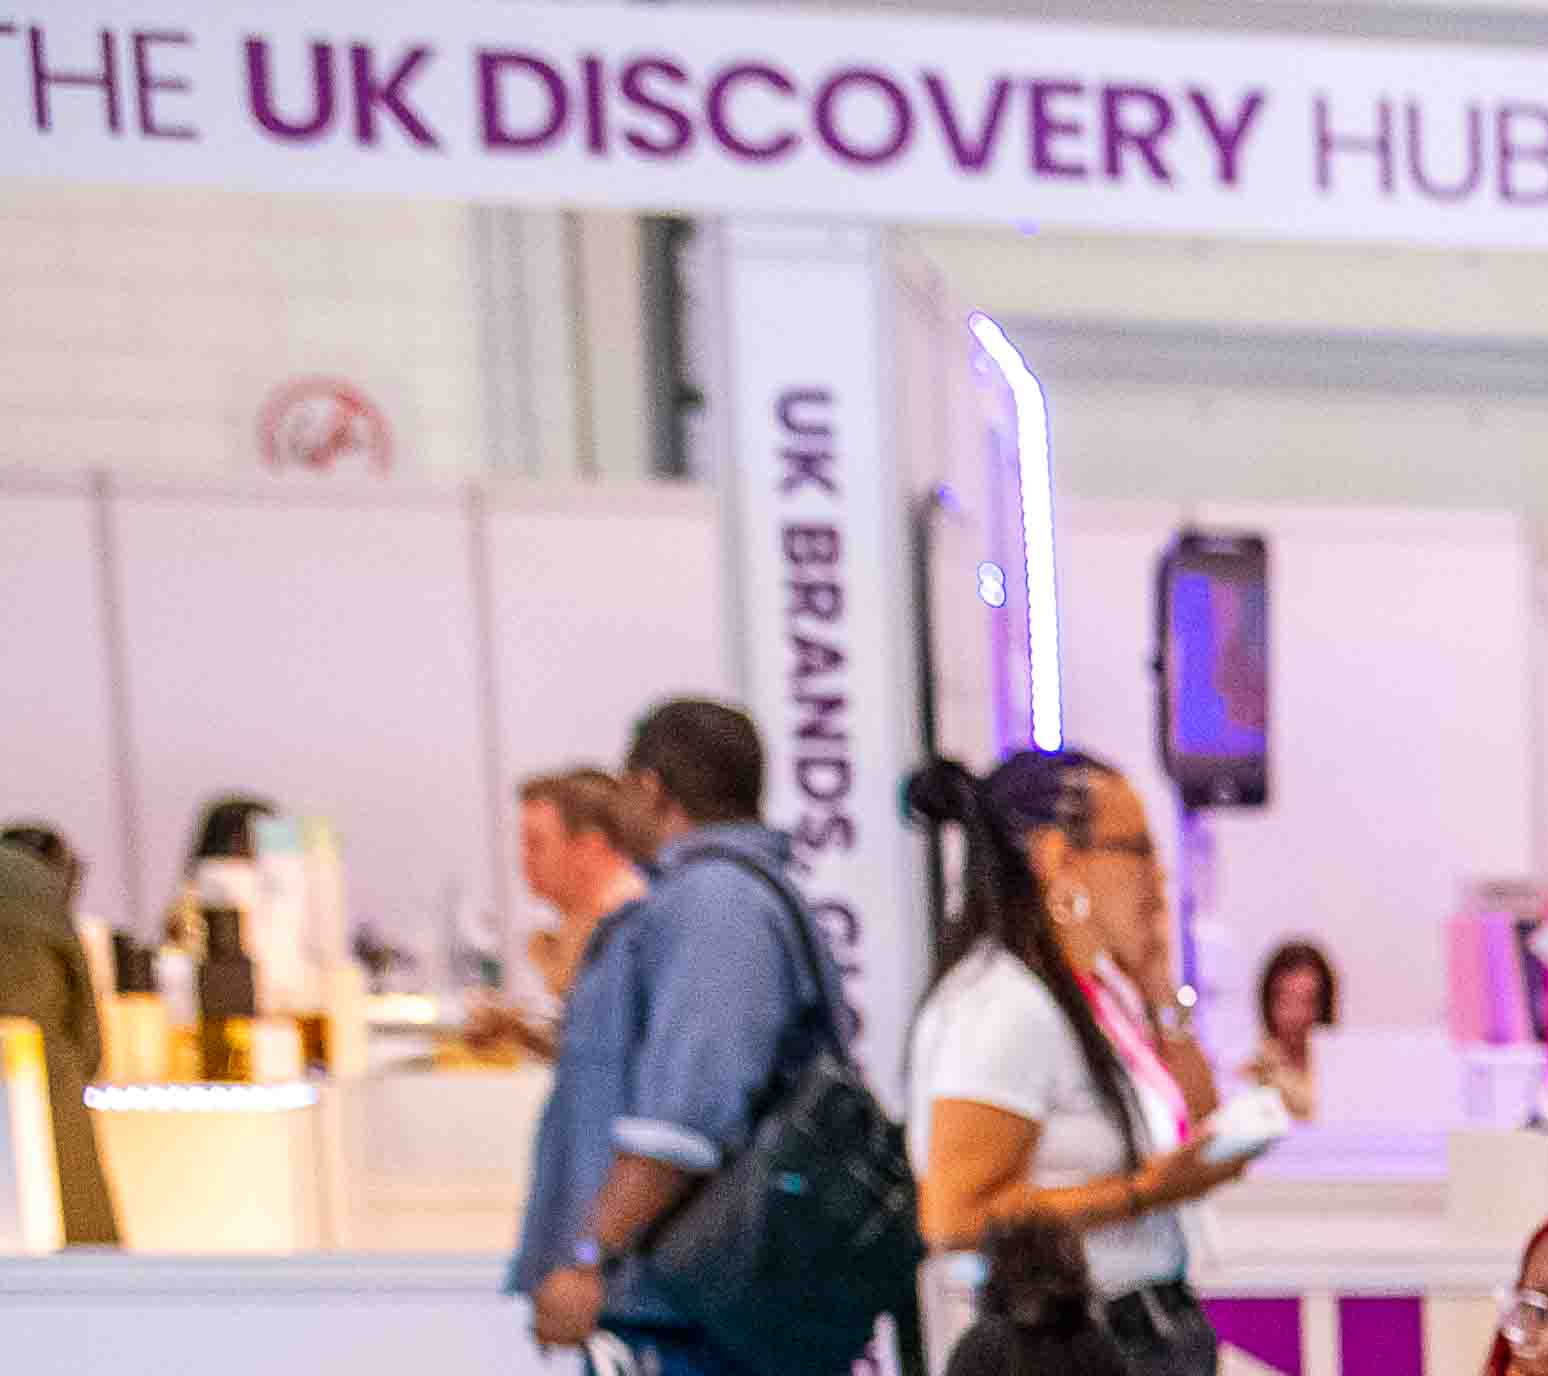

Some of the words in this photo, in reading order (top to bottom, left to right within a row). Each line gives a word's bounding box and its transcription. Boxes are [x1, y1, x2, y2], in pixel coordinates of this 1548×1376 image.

[246, 38, 442, 152] UK
[477, 52, 1267, 189] DISCOVERY
[775, 386, 839, 494] UK
